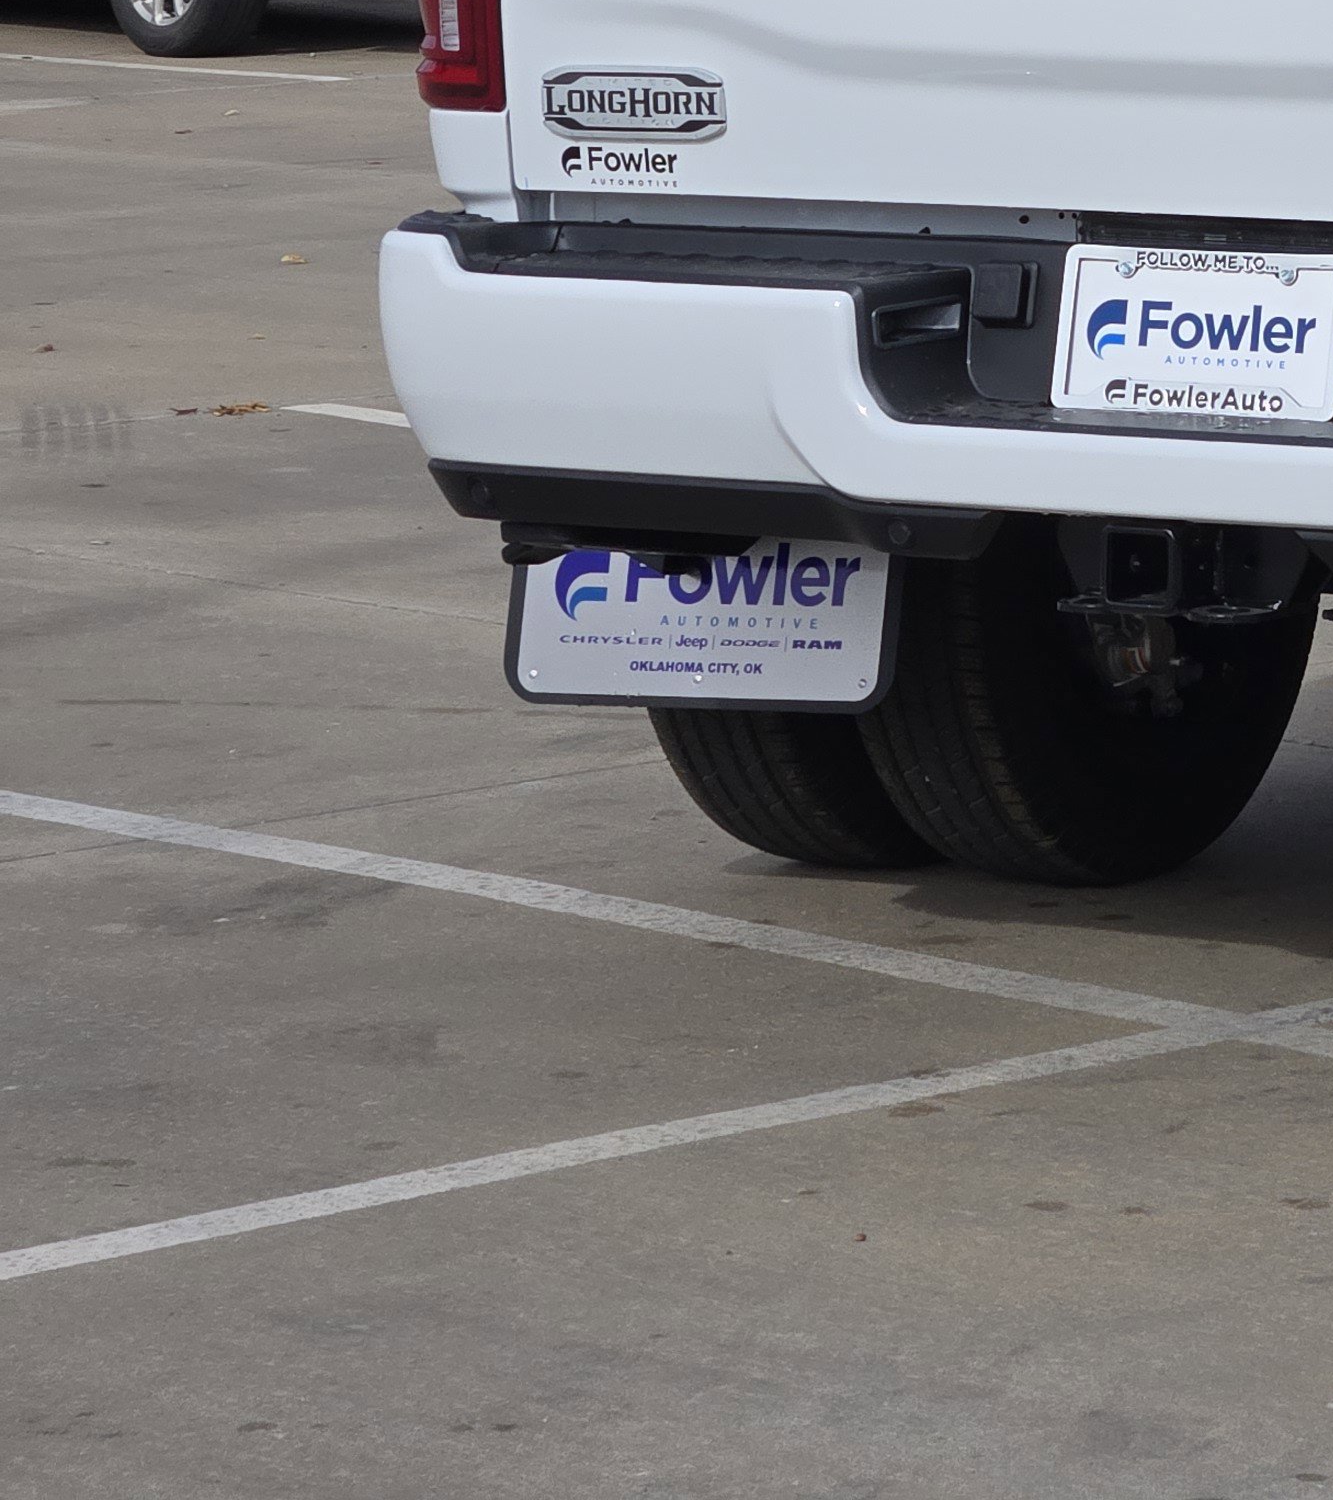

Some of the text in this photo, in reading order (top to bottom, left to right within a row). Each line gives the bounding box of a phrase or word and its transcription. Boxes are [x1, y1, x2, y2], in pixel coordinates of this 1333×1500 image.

[543, 86, 718, 118] LONGHORN
[587, 146, 677, 174] Fowler
[590, 178, 678, 188] AUTOMOTIVE
[1136, 251, 1210, 270] FOLLOW
[1211, 254, 1237, 270] ME
[1138, 299, 1317, 354] Fowler
[1164, 355, 1286, 369] AUTOMOTIVE
[1132, 382, 1284, 413] FowlerAuto
[659, 614, 819, 630] AUTOMOTIVE
[558, 633, 843, 651] CHRYSLER Jeep DODGE RAM
[629, 660, 763, 676] OKLAHOMA CITY, OK
